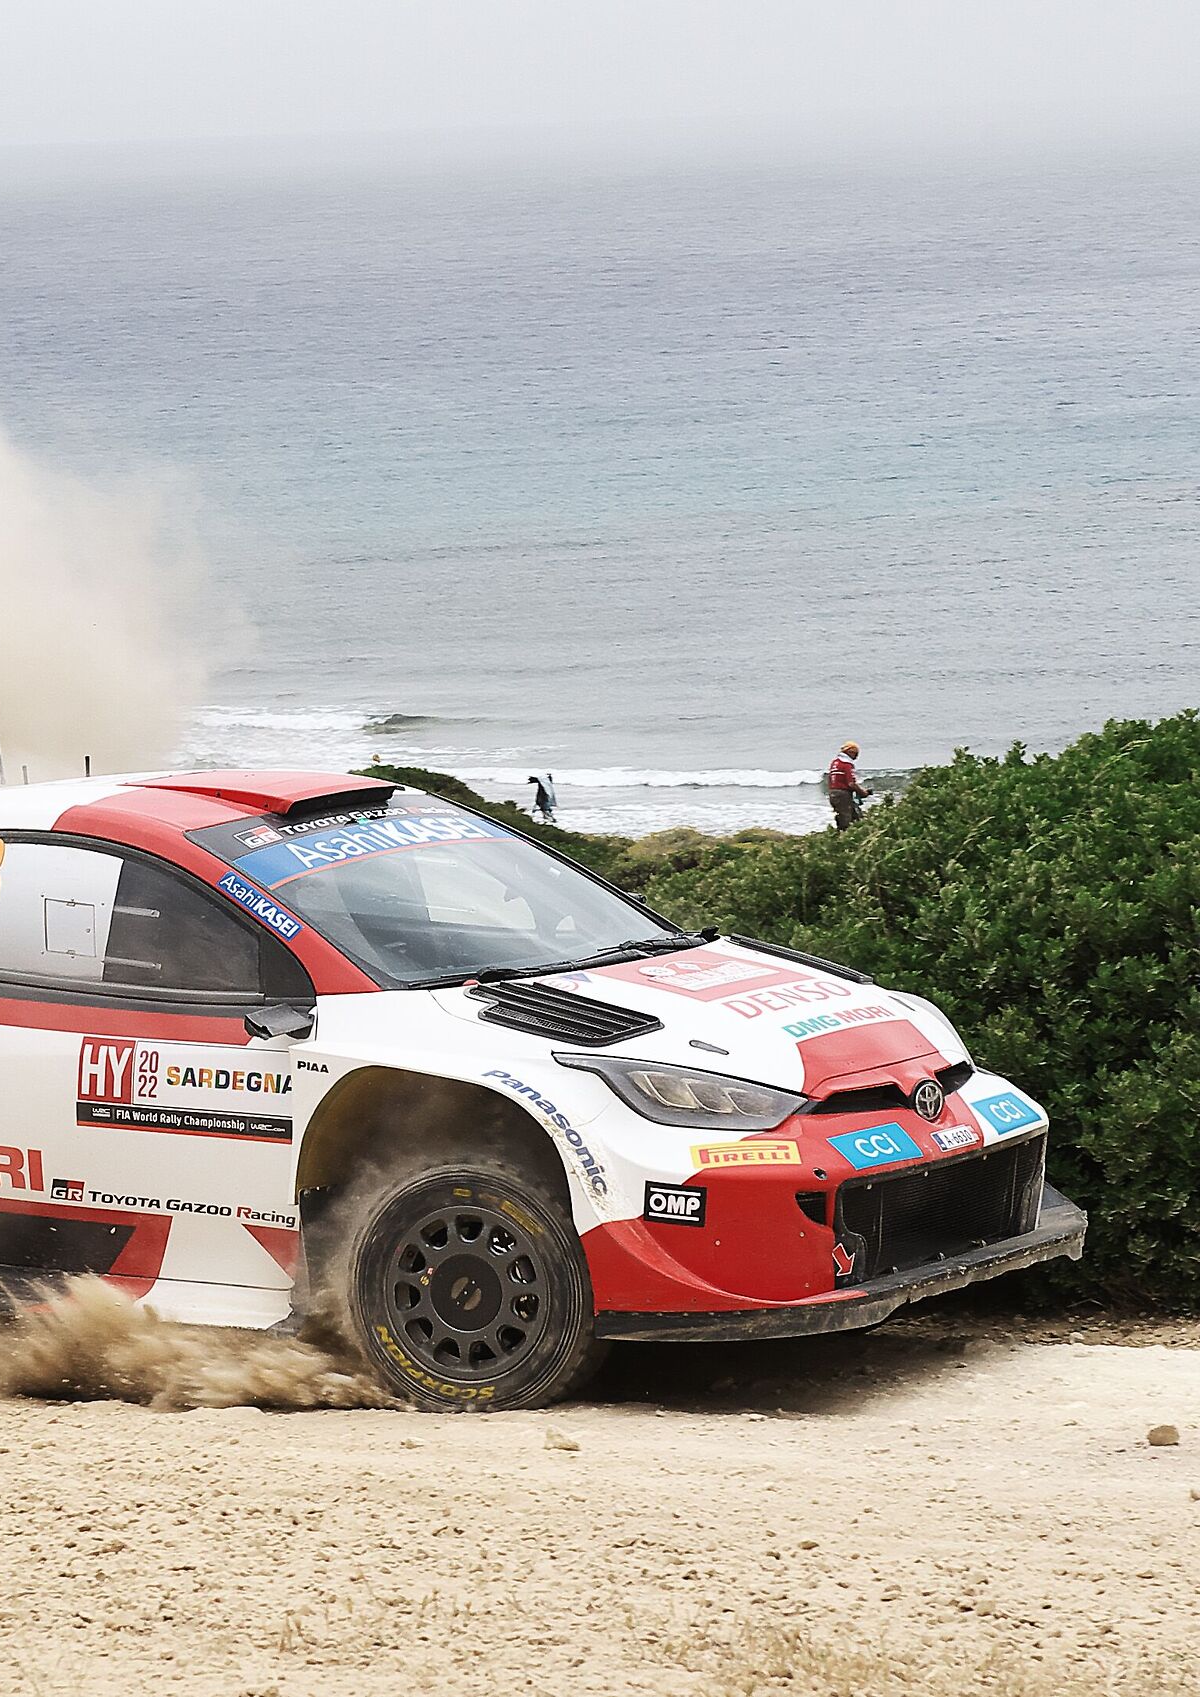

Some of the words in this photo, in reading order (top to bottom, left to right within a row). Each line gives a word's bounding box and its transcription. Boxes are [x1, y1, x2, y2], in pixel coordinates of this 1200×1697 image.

[242, 830, 283, 848] GR
[280, 816, 351, 835] TOYOTA
[349, 808, 407, 820] GAZOO
[284, 816, 494, 869] AsahiKASEI
[220, 874, 300, 942] AsahiKASEI
[721, 981, 852, 1019] DENSO
[780, 1015, 842, 1038] DMG
[833, 1005, 896, 1024] MORI
[80, 1045, 132, 1098] HY
[139, 1050, 159, 1073] 20
[296, 1060, 330, 1074] PIAA
[137, 1074, 158, 1098] 22
[166, 1066, 293, 1095] SARDEGNA
[116, 1109, 131, 1120] FIA
[132, 1111, 158, 1123] World
[159, 1114, 182, 1126] Rally
[183, 1115, 246, 1132] Championship
[481, 1069, 608, 1196] Panasonic
[699, 1145, 792, 1165] PIRELLI
[52, 1186, 83, 1201] GR
[88, 1190, 161, 1209] TOYOTA
[166, 1199, 232, 1216] GAZOO
[236, 1206, 296, 1228] Racing
[649, 1192, 700, 1216] OMP
